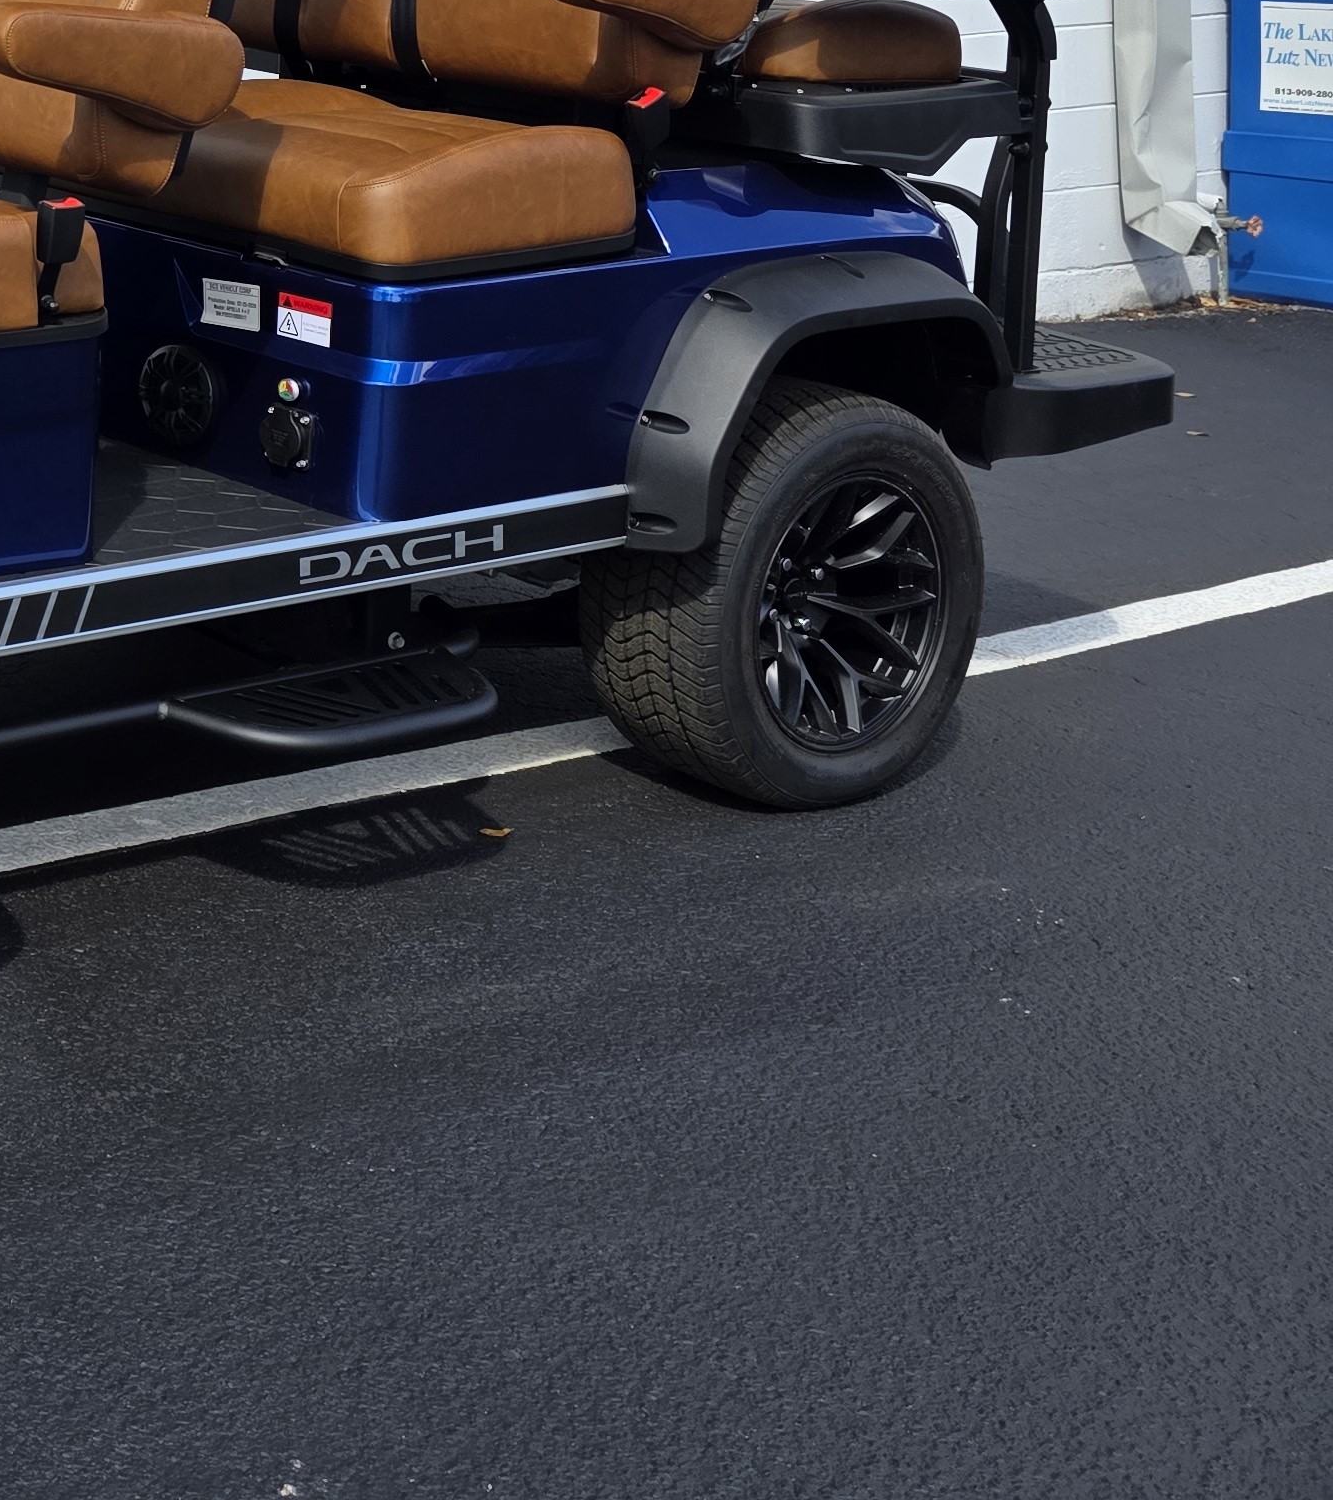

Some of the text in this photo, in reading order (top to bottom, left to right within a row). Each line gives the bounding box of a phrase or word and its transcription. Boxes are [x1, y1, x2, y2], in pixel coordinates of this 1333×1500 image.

[1264, 22, 1333, 42] The LAK
[1265, 47, 1300, 66] Lutz
[293, 299, 328, 315] WARNING
[299, 524, 504, 585] DACH
